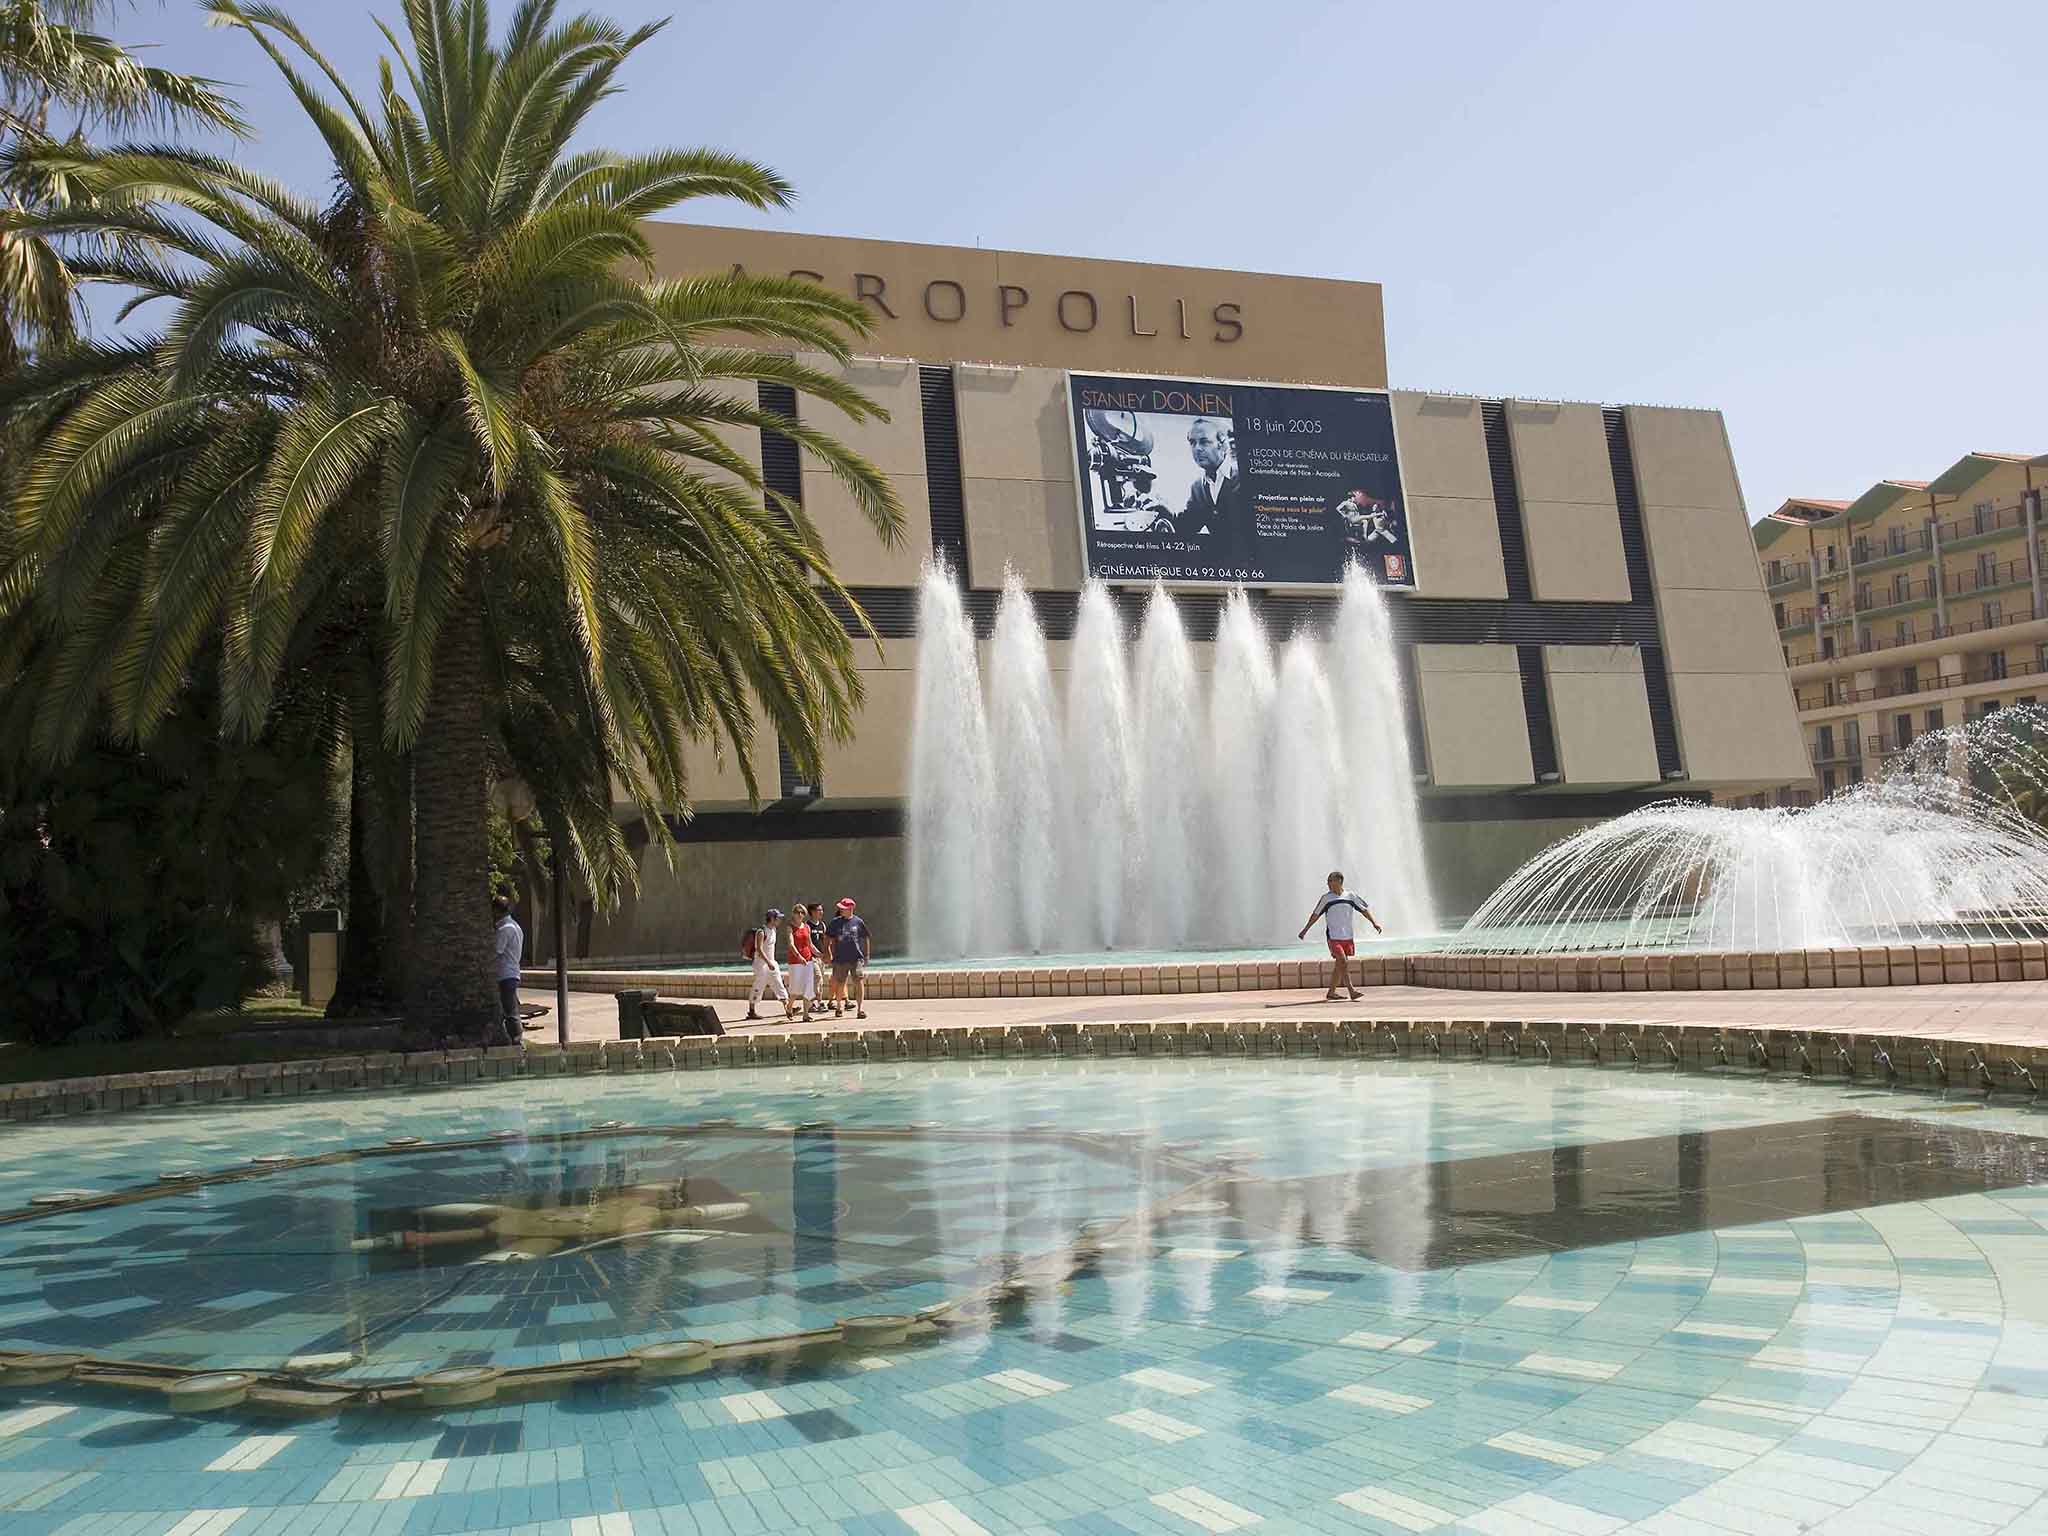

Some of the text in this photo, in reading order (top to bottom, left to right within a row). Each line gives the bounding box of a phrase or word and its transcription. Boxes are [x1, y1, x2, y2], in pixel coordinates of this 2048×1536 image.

[727, 262, 1244, 344] ROPOLIS
[1082, 390, 1233, 415] STANLEY DONEN
[1246, 417, 1322, 435] 18 juin 2005
[1283, 449, 1293, 458] DE
[1330, 451, 1342, 460] DU
[1135, 541, 1145, 549] des
[1187, 542, 1201, 553] juin
[1185, 567, 1199, 577] 04
[1201, 567, 1215, 578] 92
[1218, 568, 1232, 578] 04
[1235, 568, 1248, 579] 06
[1251, 568, 1266, 579] 66
